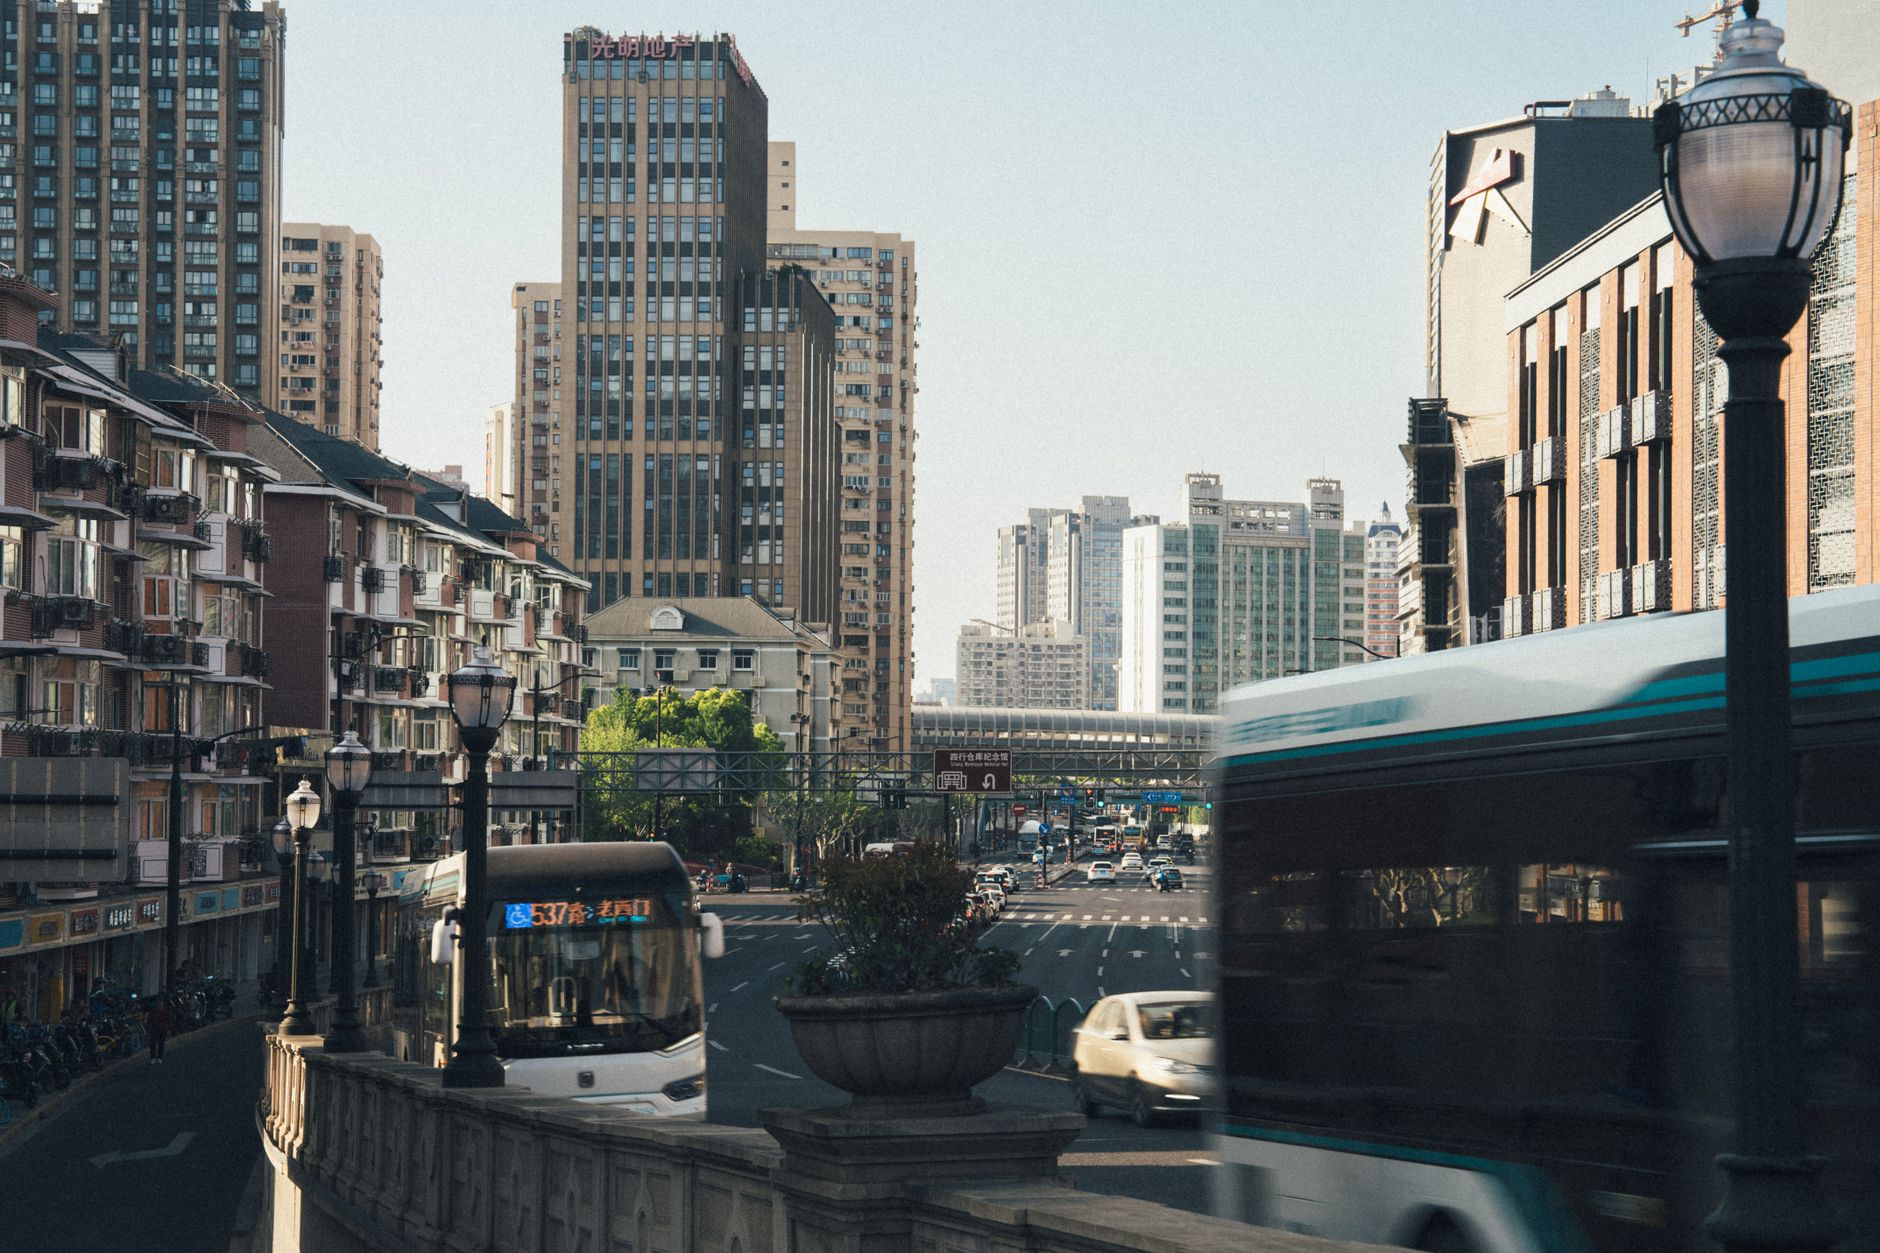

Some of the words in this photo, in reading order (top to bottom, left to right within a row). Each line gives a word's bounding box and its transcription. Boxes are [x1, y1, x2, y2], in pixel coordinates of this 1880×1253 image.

[592, 35, 693, 59] 光明地产
[950, 752, 1009, 761] 四行仓库纪念馆
[531, 902, 586, 926] 537路
[597, 900, 650, 916] 老西门
